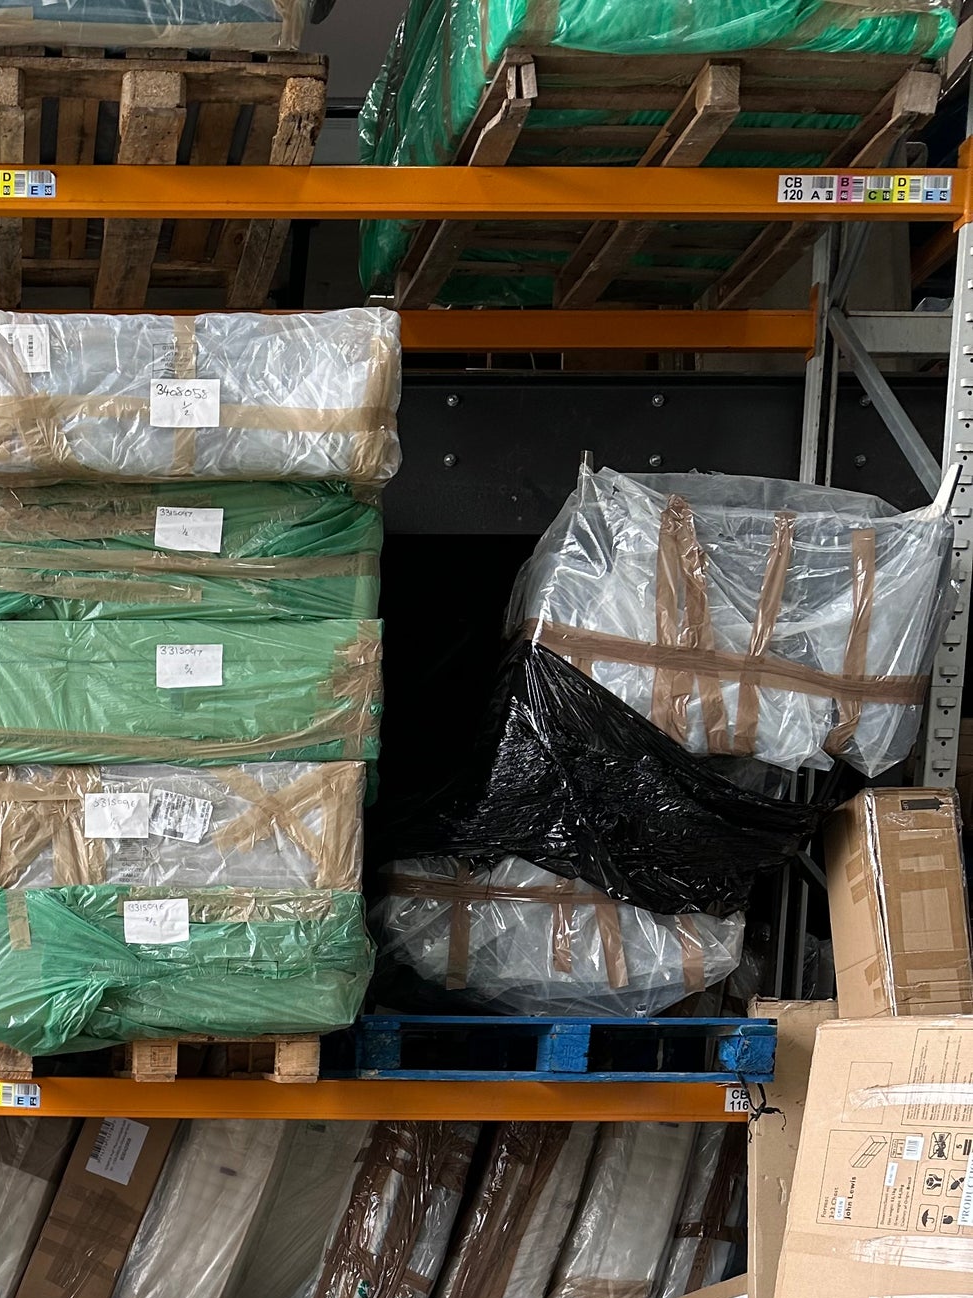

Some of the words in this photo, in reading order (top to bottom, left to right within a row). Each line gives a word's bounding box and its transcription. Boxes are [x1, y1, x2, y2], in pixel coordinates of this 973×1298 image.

[3, 172, 11, 182] D
[784, 177, 803, 188] CB
[841, 177, 849, 187] B
[898, 178, 907, 187] D
[31, 185, 38, 195] E
[783, 189, 803, 201] 120
[811, 191, 820, 200] A
[868, 191, 877, 201] C
[925, 191, 933, 201] E
[156, 383, 208, 399] 3408058
[902, 801, 909, 810] UP
[731, 1089, 748, 1100] CB
[17, 1096, 24, 1105] E
[729, 1100, 749, 1111] 116
[847, 1176, 857, 1200] Lewis
[844, 1201, 853, 1220] John
